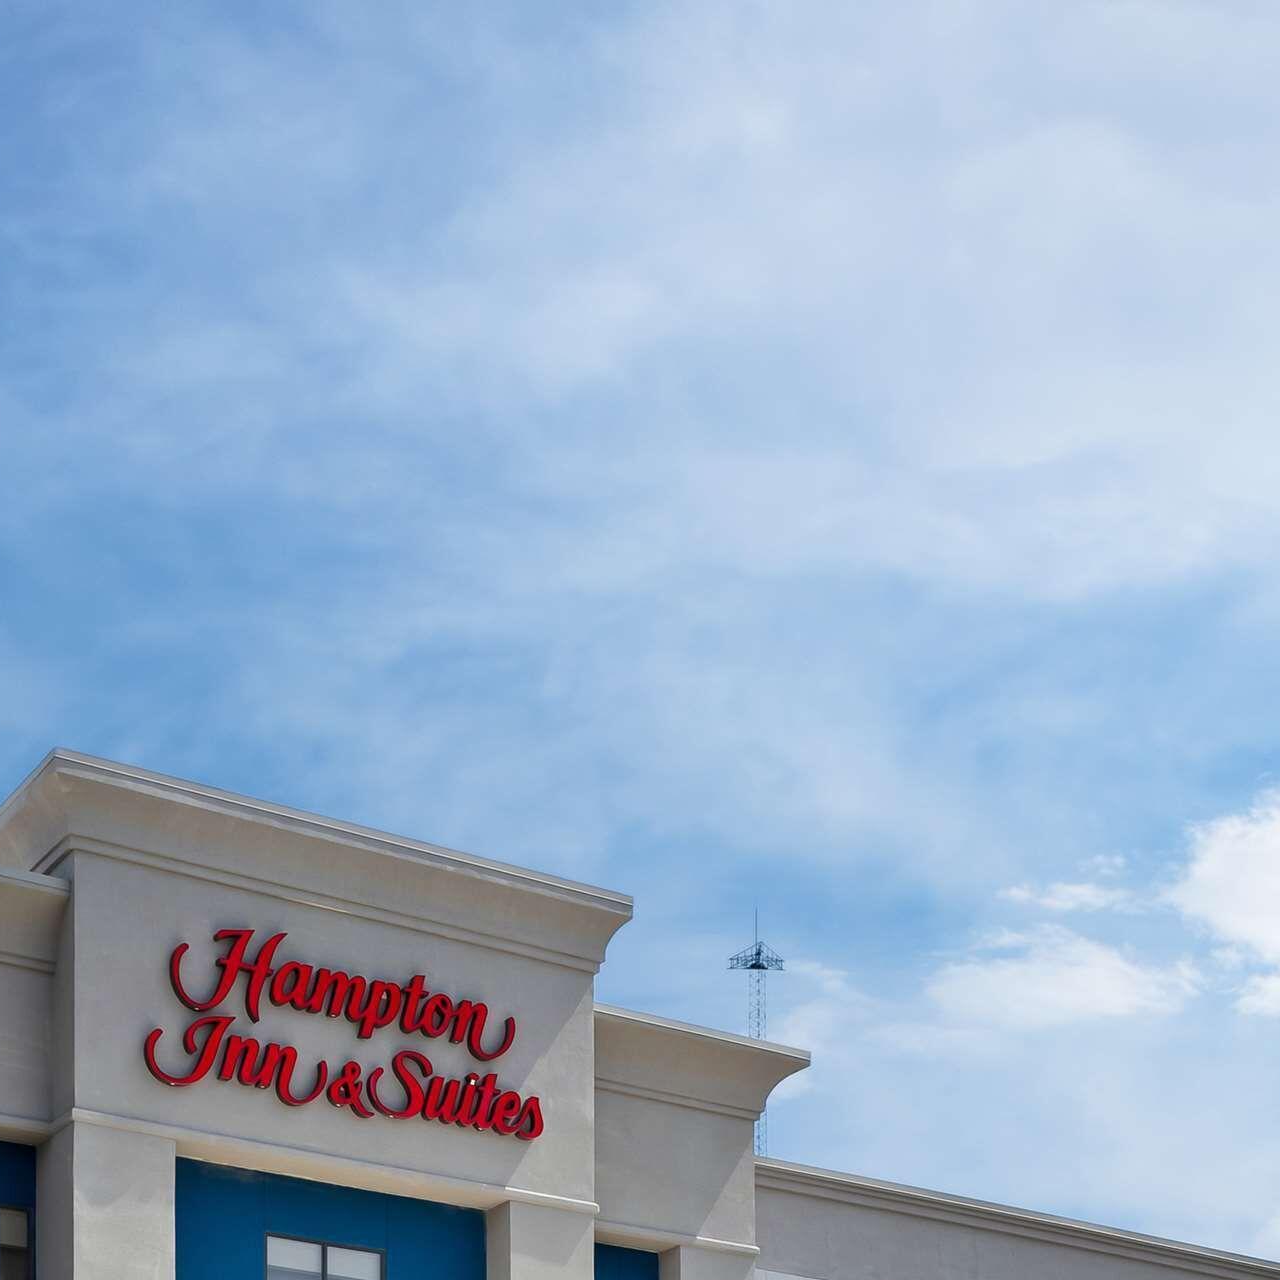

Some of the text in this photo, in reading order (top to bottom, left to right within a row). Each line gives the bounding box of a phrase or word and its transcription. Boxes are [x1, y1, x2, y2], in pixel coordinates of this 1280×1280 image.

[169, 929, 516, 1062] Hampton
[144, 1015, 545, 1141] Inn & Suites
